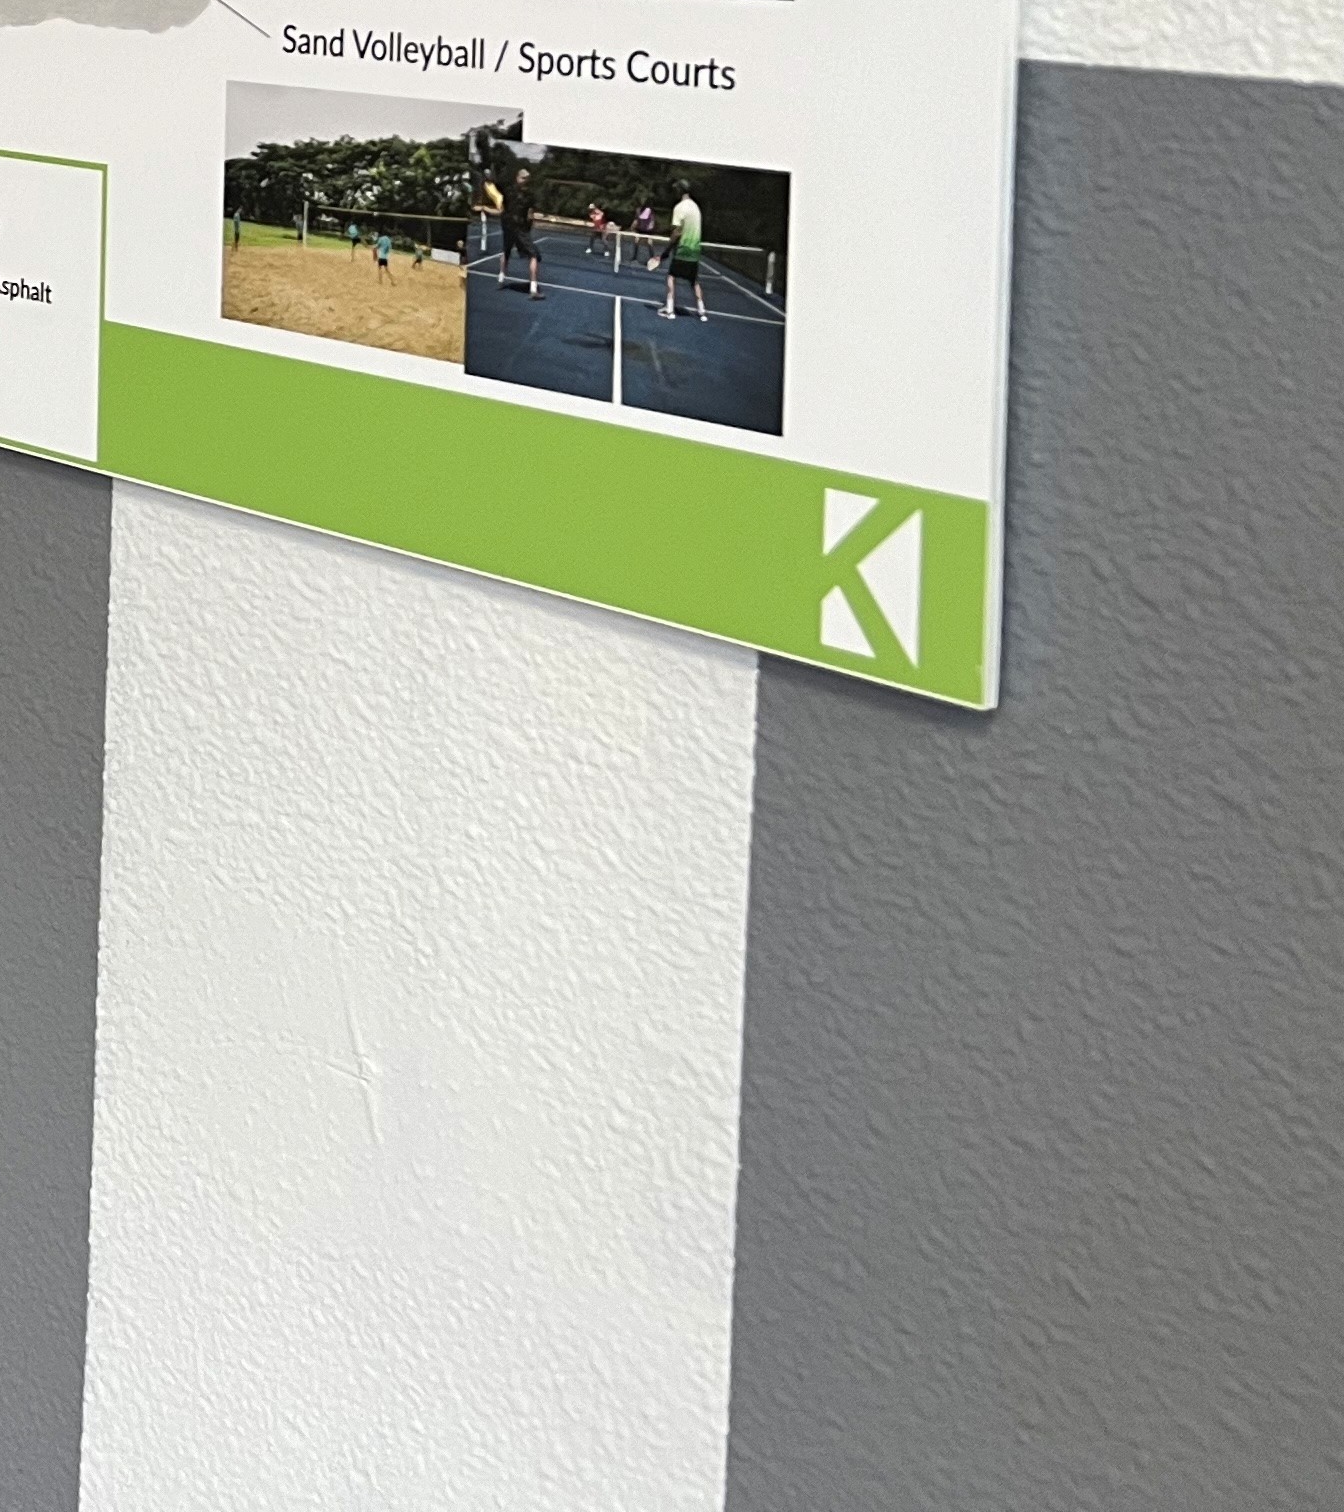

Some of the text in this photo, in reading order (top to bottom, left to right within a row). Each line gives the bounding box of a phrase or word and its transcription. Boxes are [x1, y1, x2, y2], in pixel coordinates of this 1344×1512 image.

[282, 24, 736, 91] Sand Volleyball / Sports Courts
